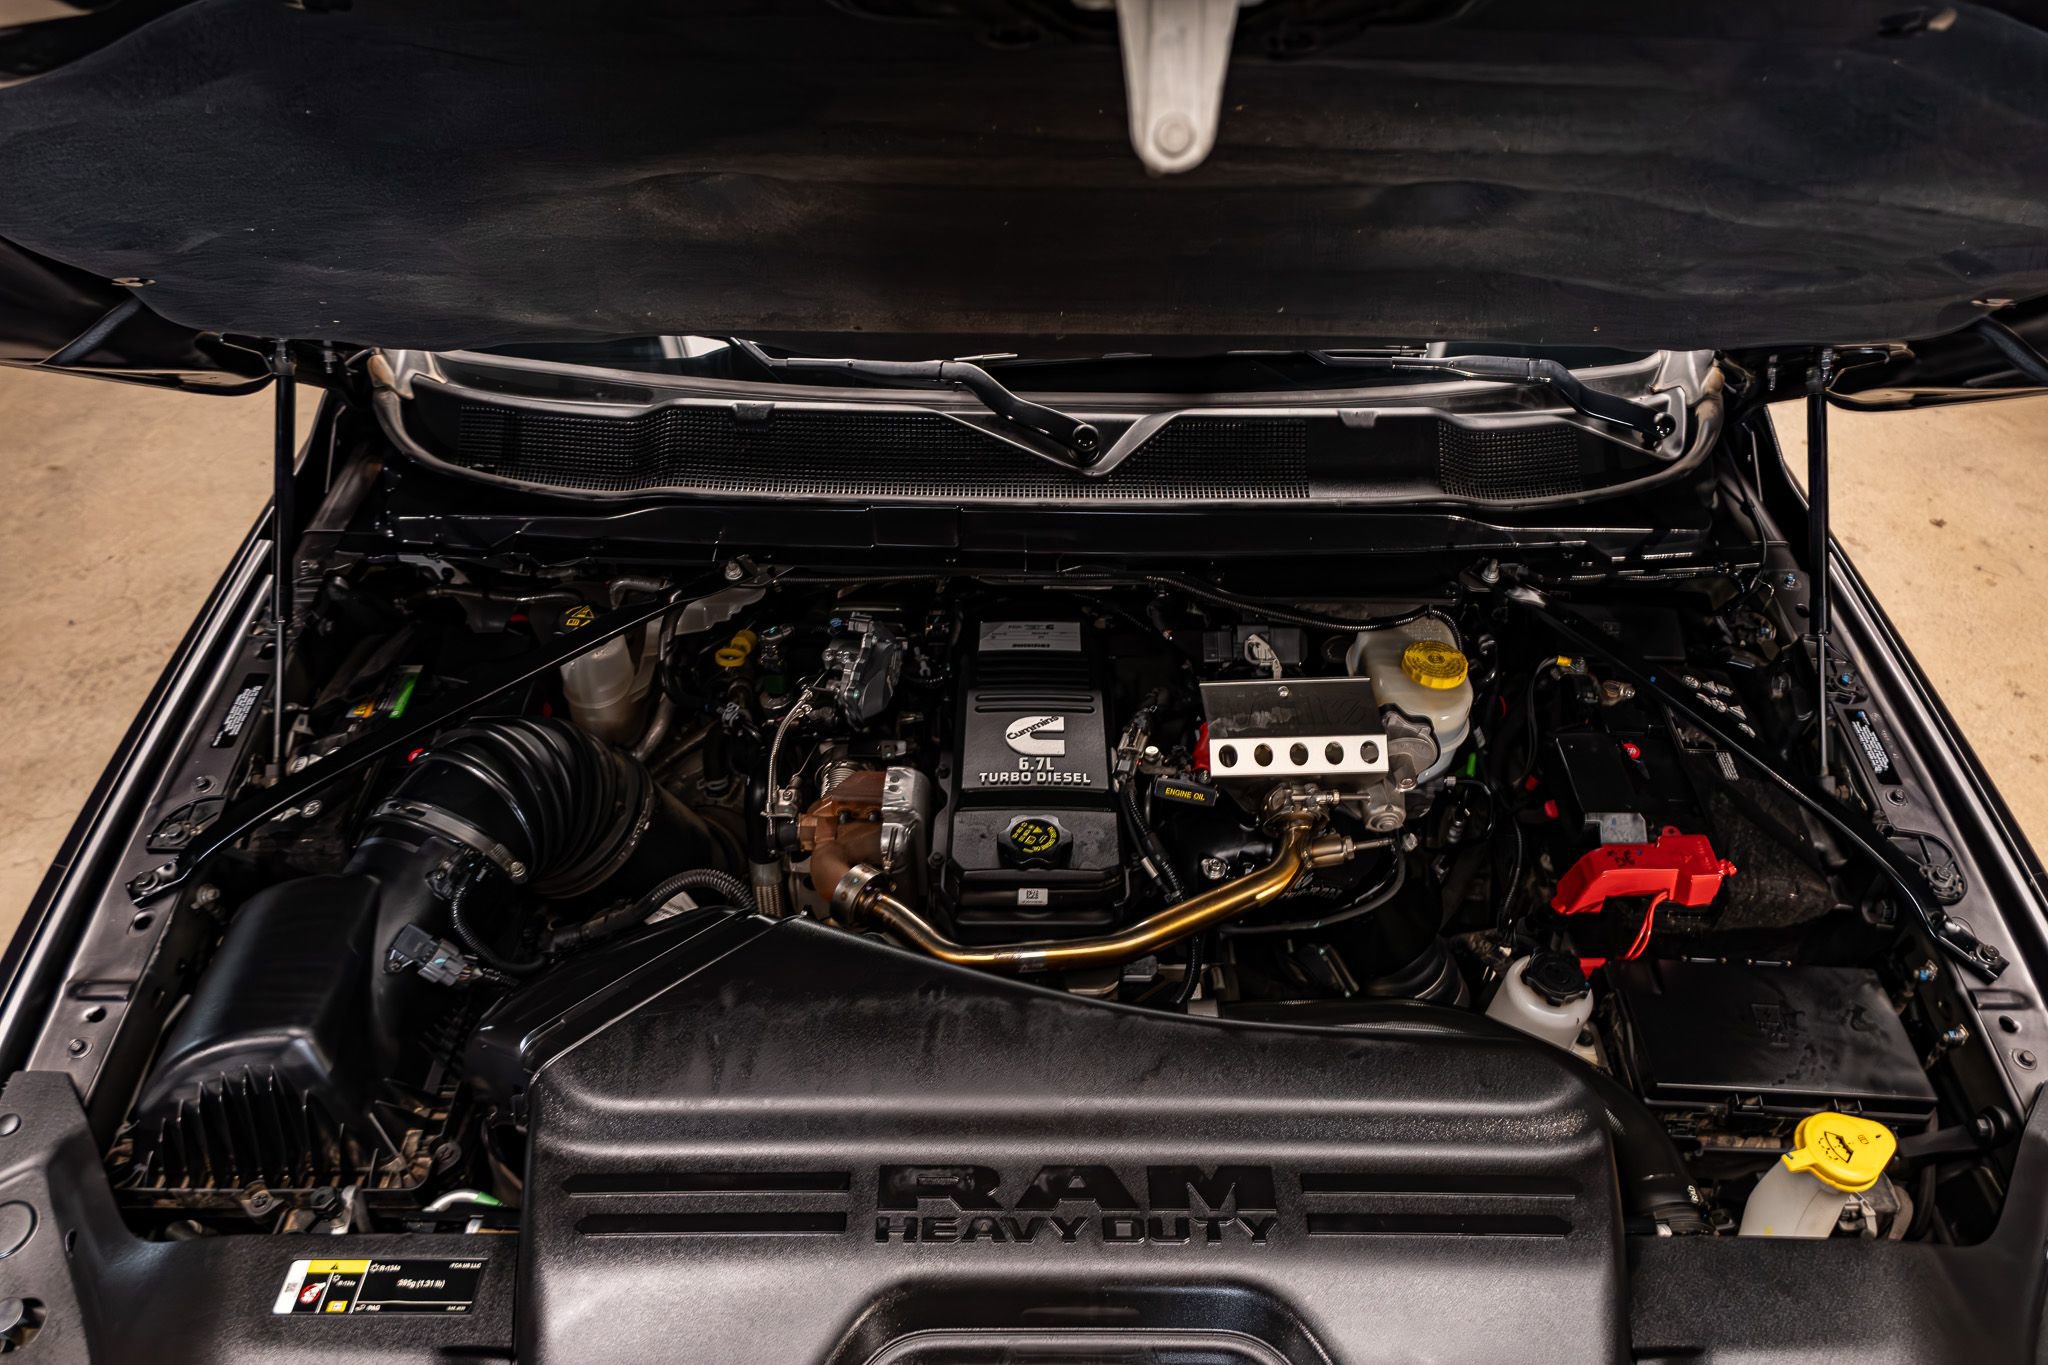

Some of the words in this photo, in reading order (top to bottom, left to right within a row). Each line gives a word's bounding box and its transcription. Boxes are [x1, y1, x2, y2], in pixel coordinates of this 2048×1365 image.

[1006, 716, 1059, 740] Cummins
[1018, 757, 1055, 771] 6.7L
[979, 772, 1032, 783] TURBO
[1036, 772, 1091, 783] DIESEL
[1165, 787, 1192, 799] ENGINE
[1193, 792, 1206, 801] OIL
[876, 1164, 1278, 1213] RAM
[875, 1215, 1090, 1244] HEAVY
[1101, 1215, 1278, 1244] DUTY
